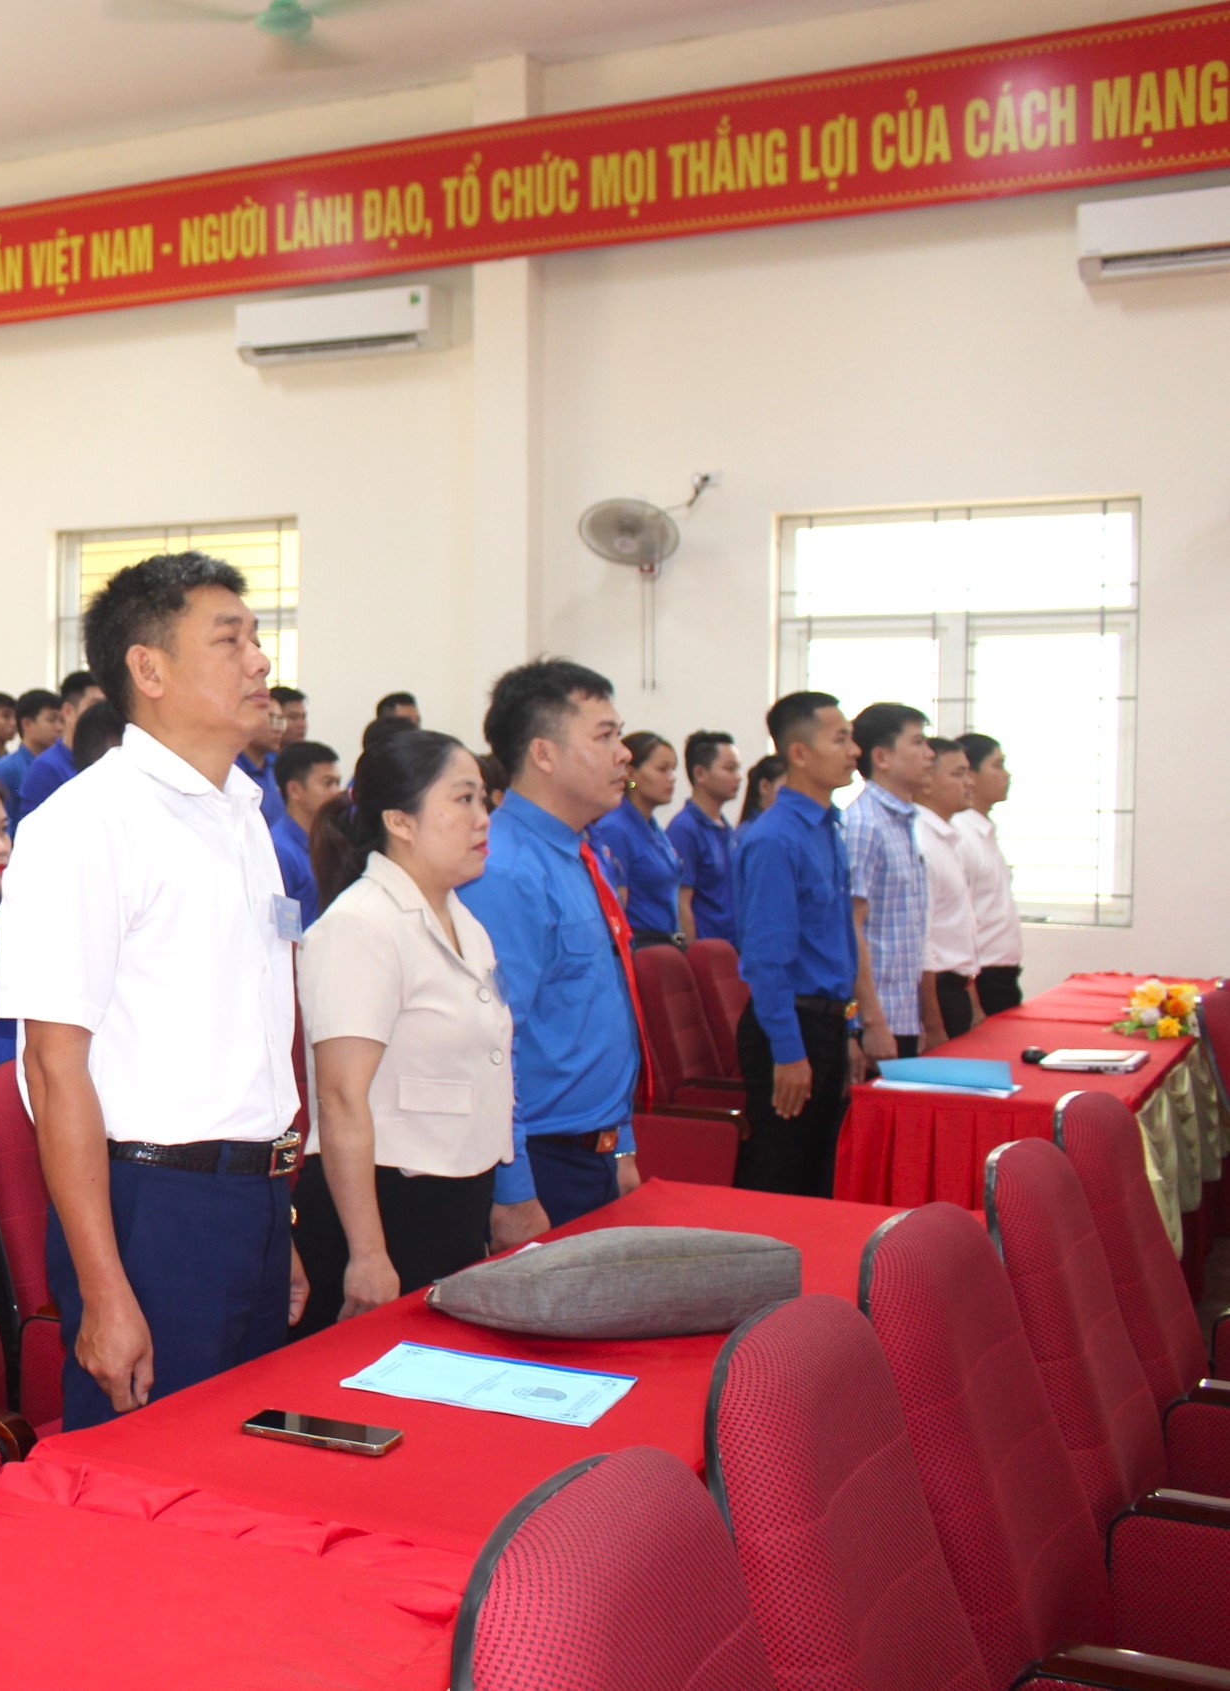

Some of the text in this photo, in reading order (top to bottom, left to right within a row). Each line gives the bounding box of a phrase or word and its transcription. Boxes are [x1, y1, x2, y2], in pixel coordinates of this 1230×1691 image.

[29, 228, 85, 296] VIỆT
[90, 223, 154, 280] NAM
[179, 194, 268, 267] NGƯỜI
[275, 188, 354, 253] LÃNH
[362, 181, 433, 250] ĐẠO,
[441, 152, 483, 229] TỔ
[490, 150, 579, 222] CHỨC
[591, 147, 657, 218] MỌI
[668, 115, 788, 199] THẮNG
[799, 114, 858, 191] LỢI
[869, 88, 952, 169] CỦA
[964, 82, 1077, 158] CÁCH
[1092, 60, 1229, 149] MẠNG
